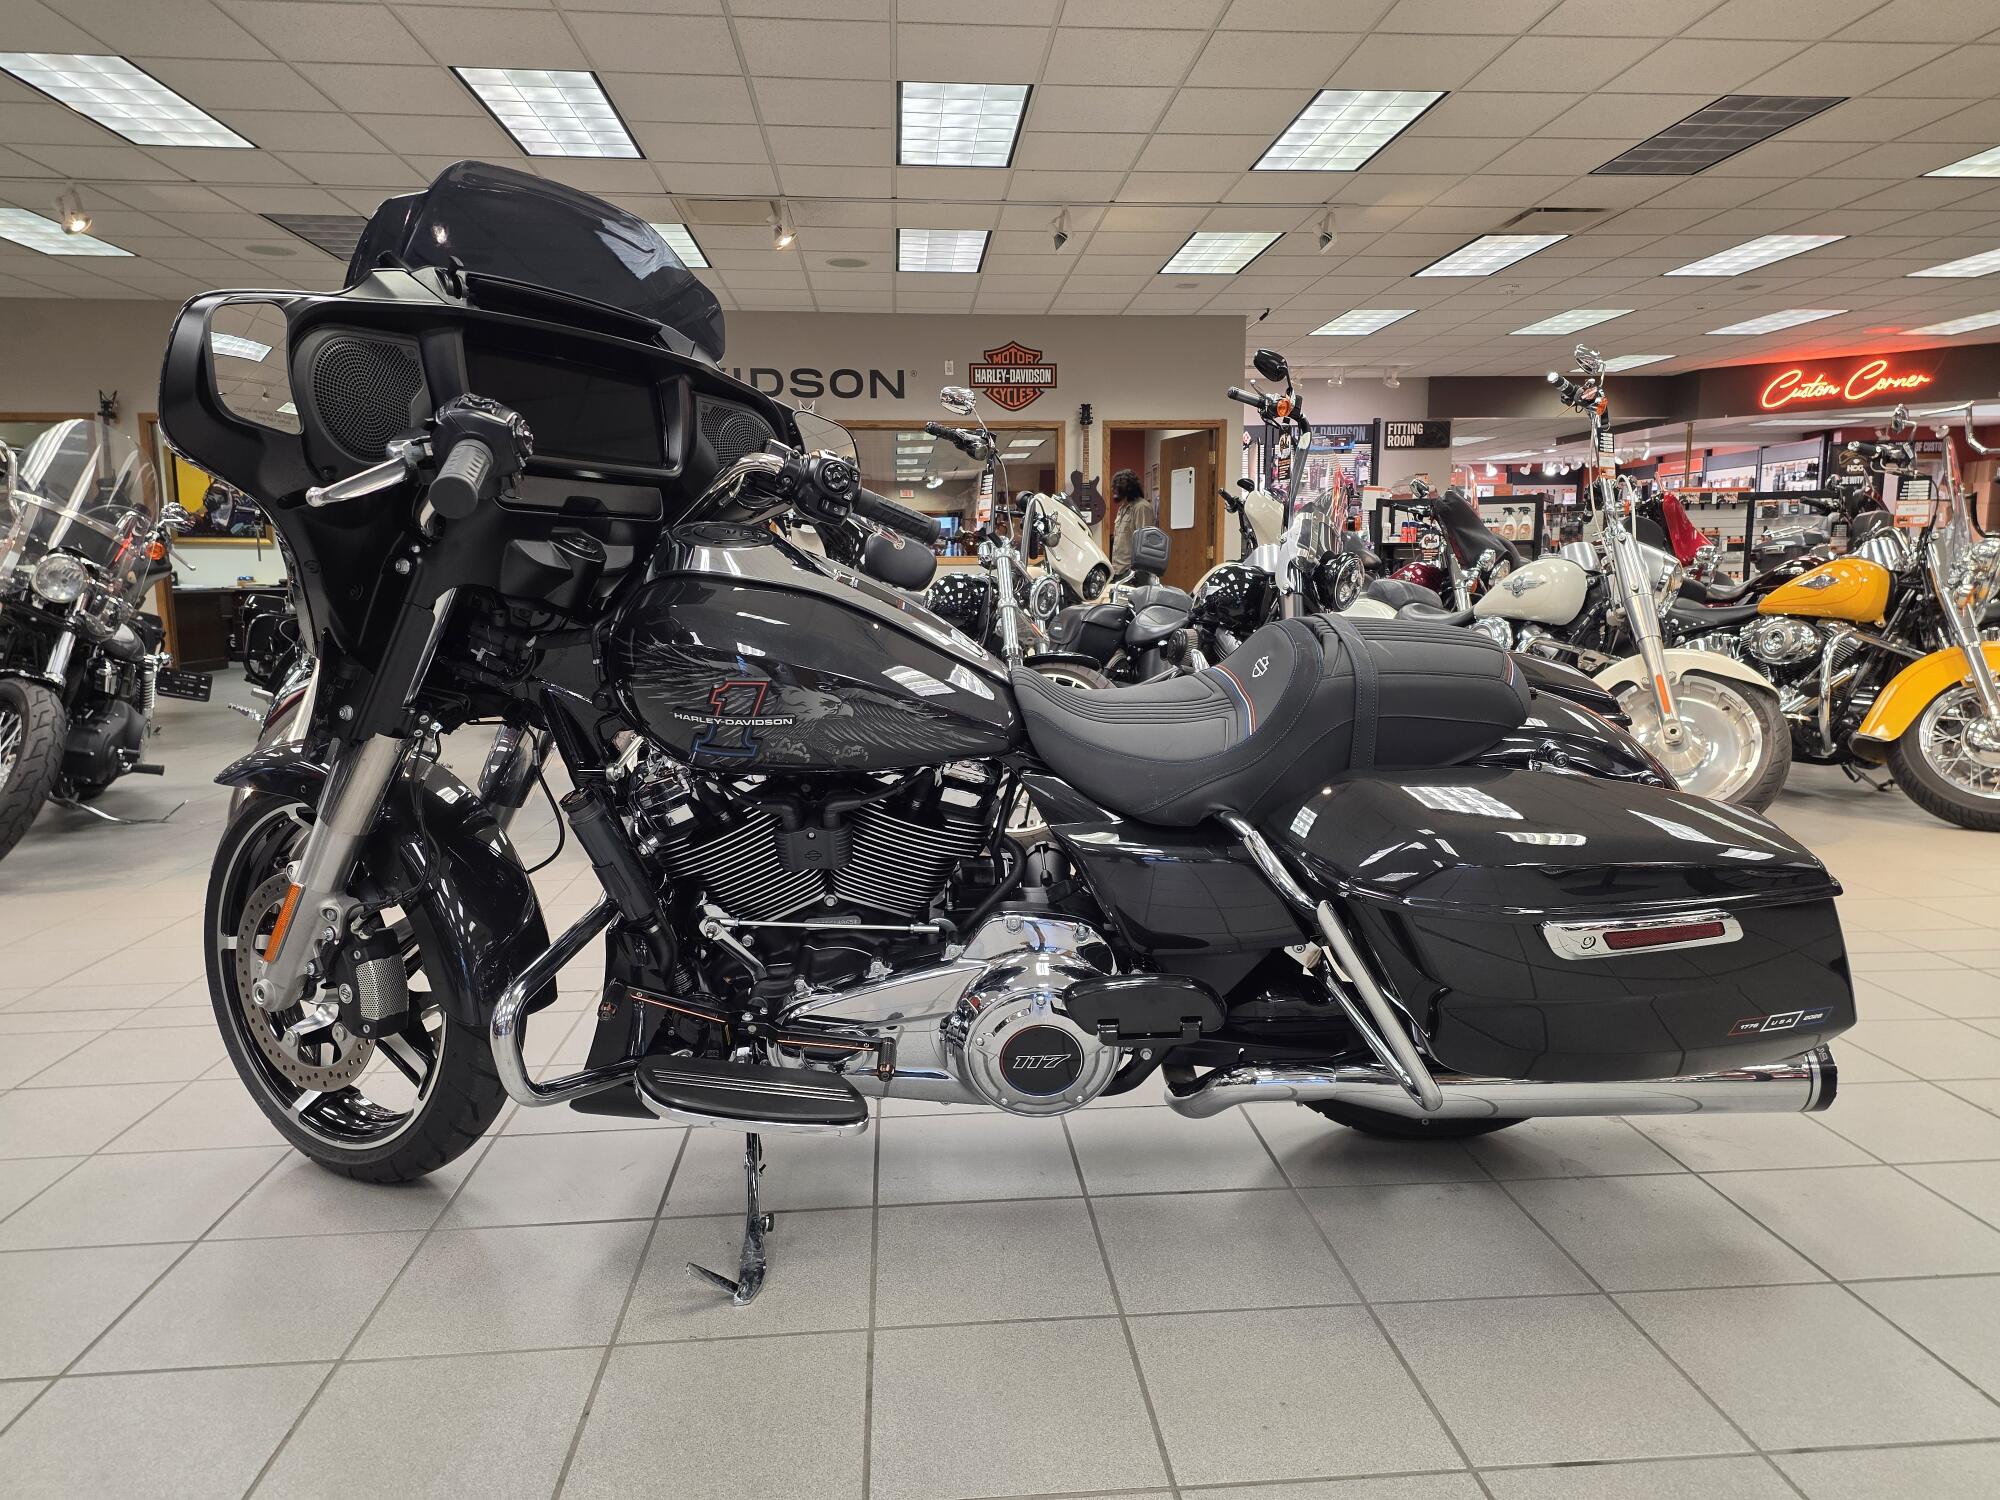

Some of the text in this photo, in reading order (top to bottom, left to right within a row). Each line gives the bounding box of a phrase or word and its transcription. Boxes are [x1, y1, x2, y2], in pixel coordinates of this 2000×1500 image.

[993, 347, 1034, 364] MOTOR
[974, 368, 1052, 383] HARLEY-DAVIDSON
[1761, 359, 1931, 409] Custom Corner
[993, 387, 1034, 406] CYCLES
[1387, 423, 1424, 435] FITTING
[1387, 435, 1415, 447] ROOM
[673, 712, 794, 726] HARLEY-DAVIDSON
[1770, 1018, 1792, 1026] USA
[1013, 1054, 1072, 1069] 117
